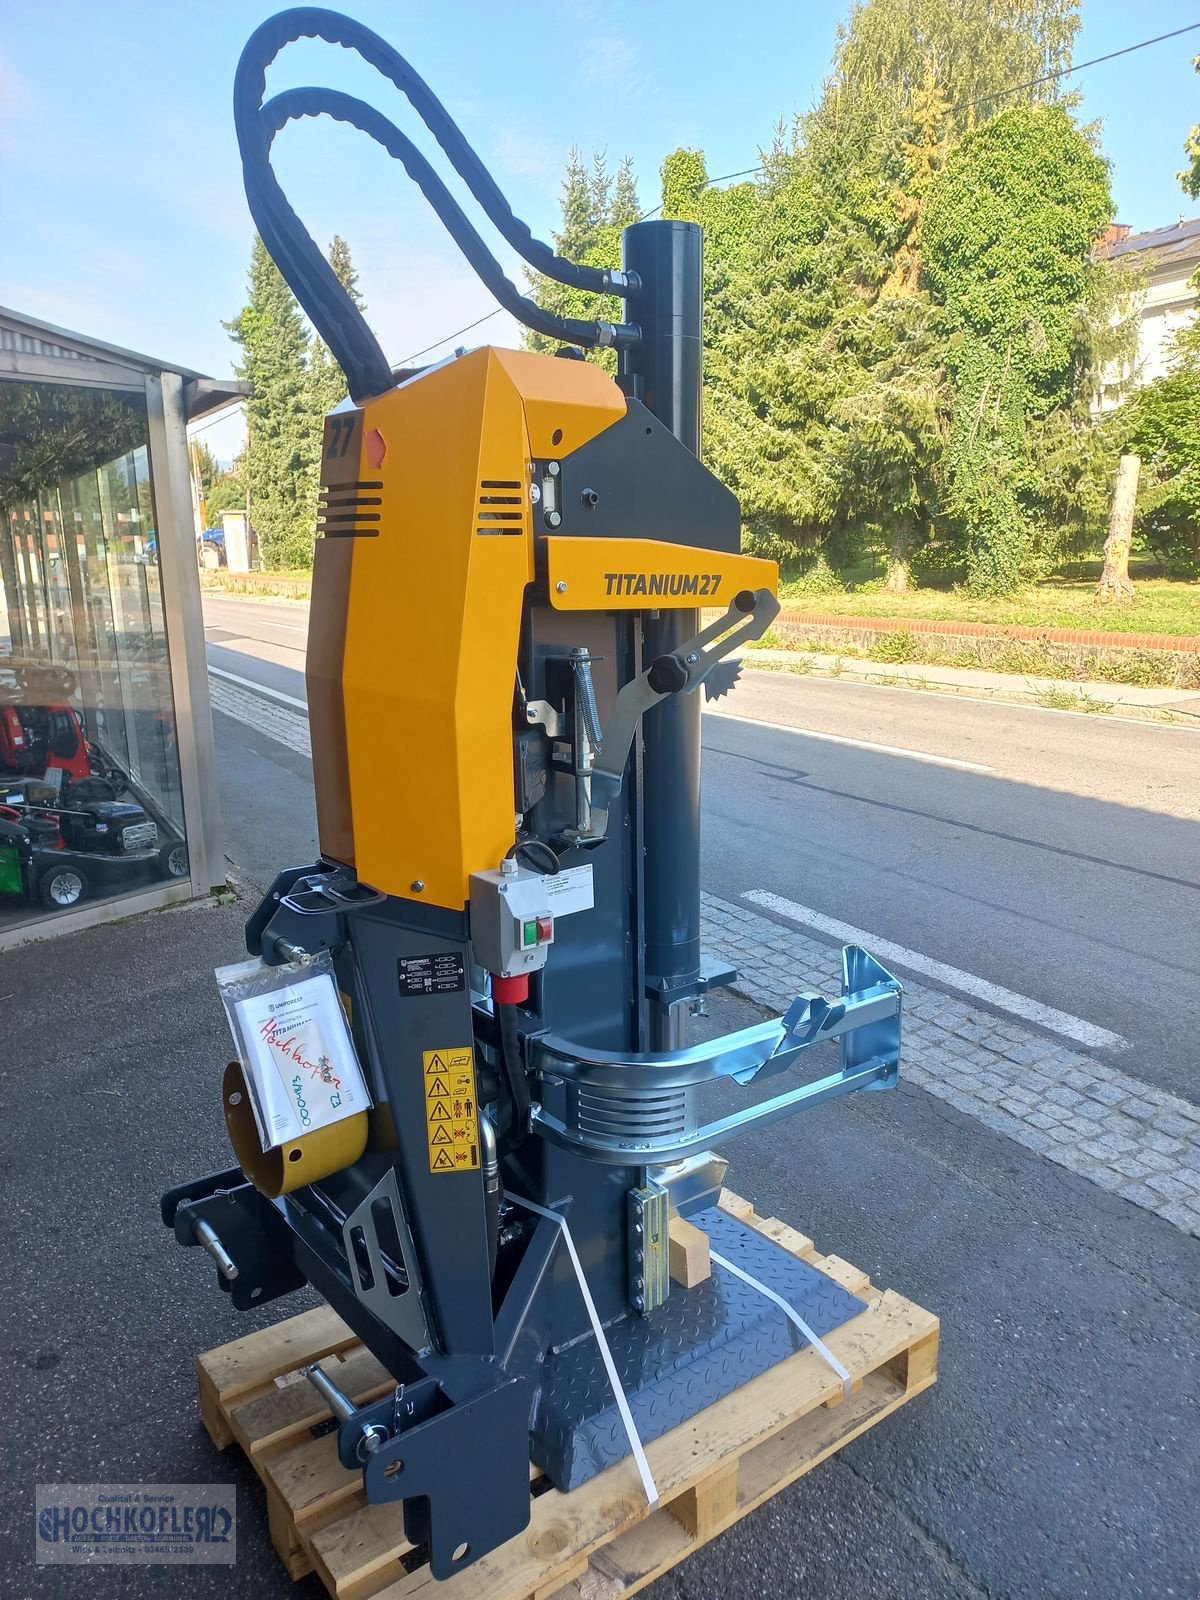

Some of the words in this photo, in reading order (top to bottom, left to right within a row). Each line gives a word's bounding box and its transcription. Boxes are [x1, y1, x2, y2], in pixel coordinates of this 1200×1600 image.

[328, 417, 355, 459] 27
[604, 573, 722, 596] TITANIUM27
[275, 996, 304, 1009] UNIFOREST
